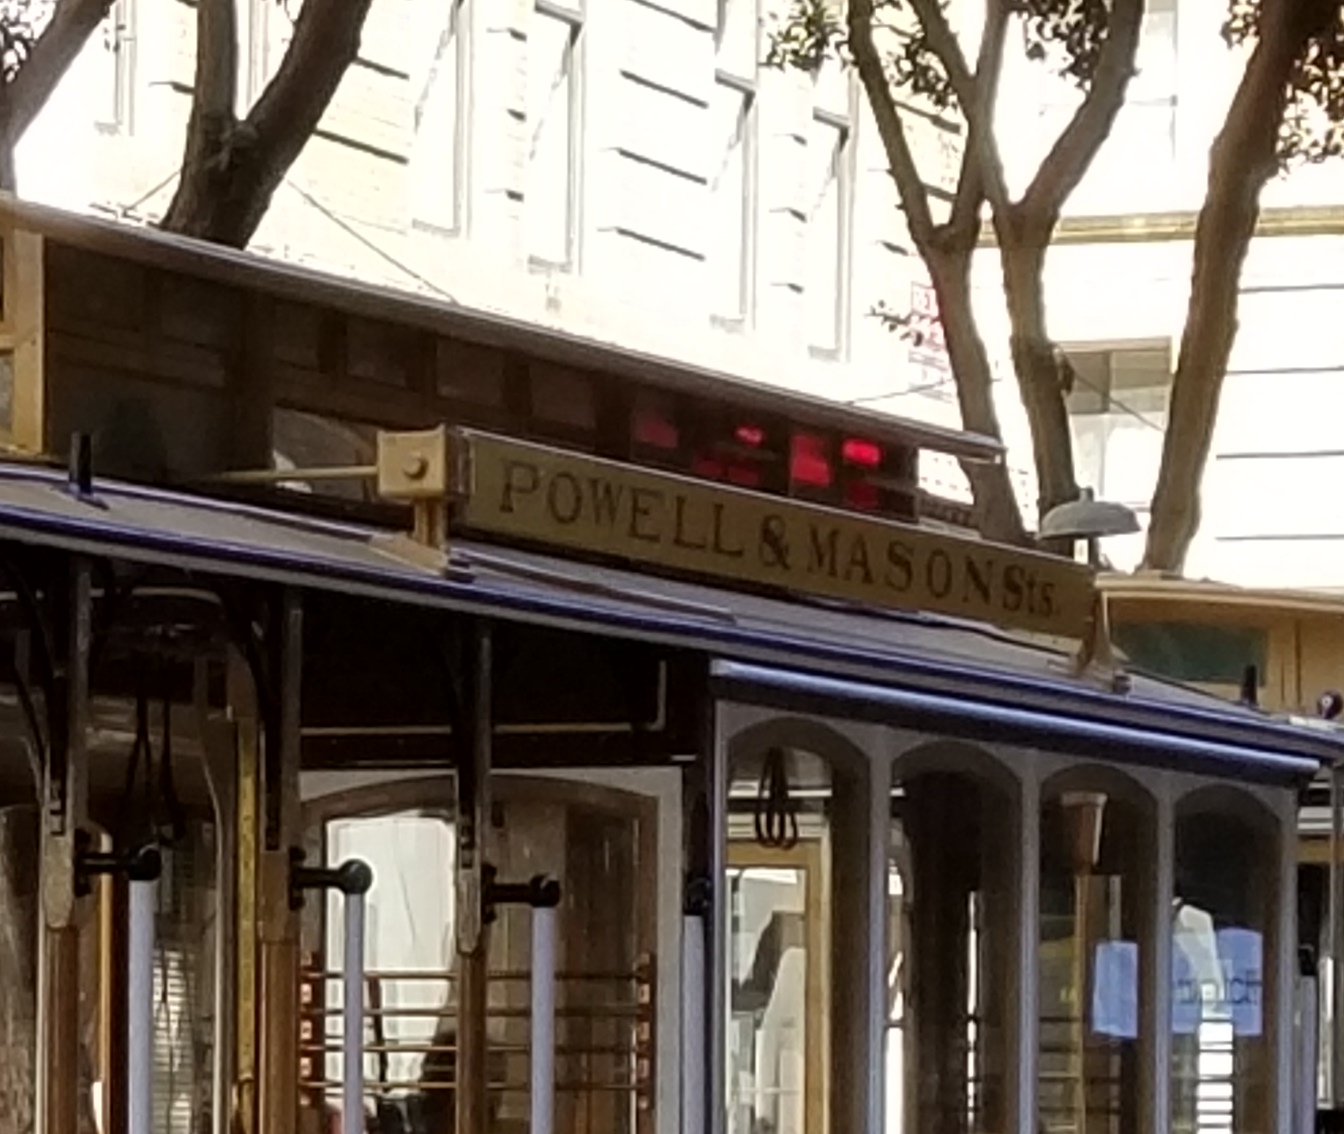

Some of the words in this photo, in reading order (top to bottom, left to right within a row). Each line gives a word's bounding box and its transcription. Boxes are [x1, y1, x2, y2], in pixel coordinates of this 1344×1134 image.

[499, 460, 744, 557] POWELL
[759, 514, 791, 571] &
[807, 524, 995, 606] MASON
